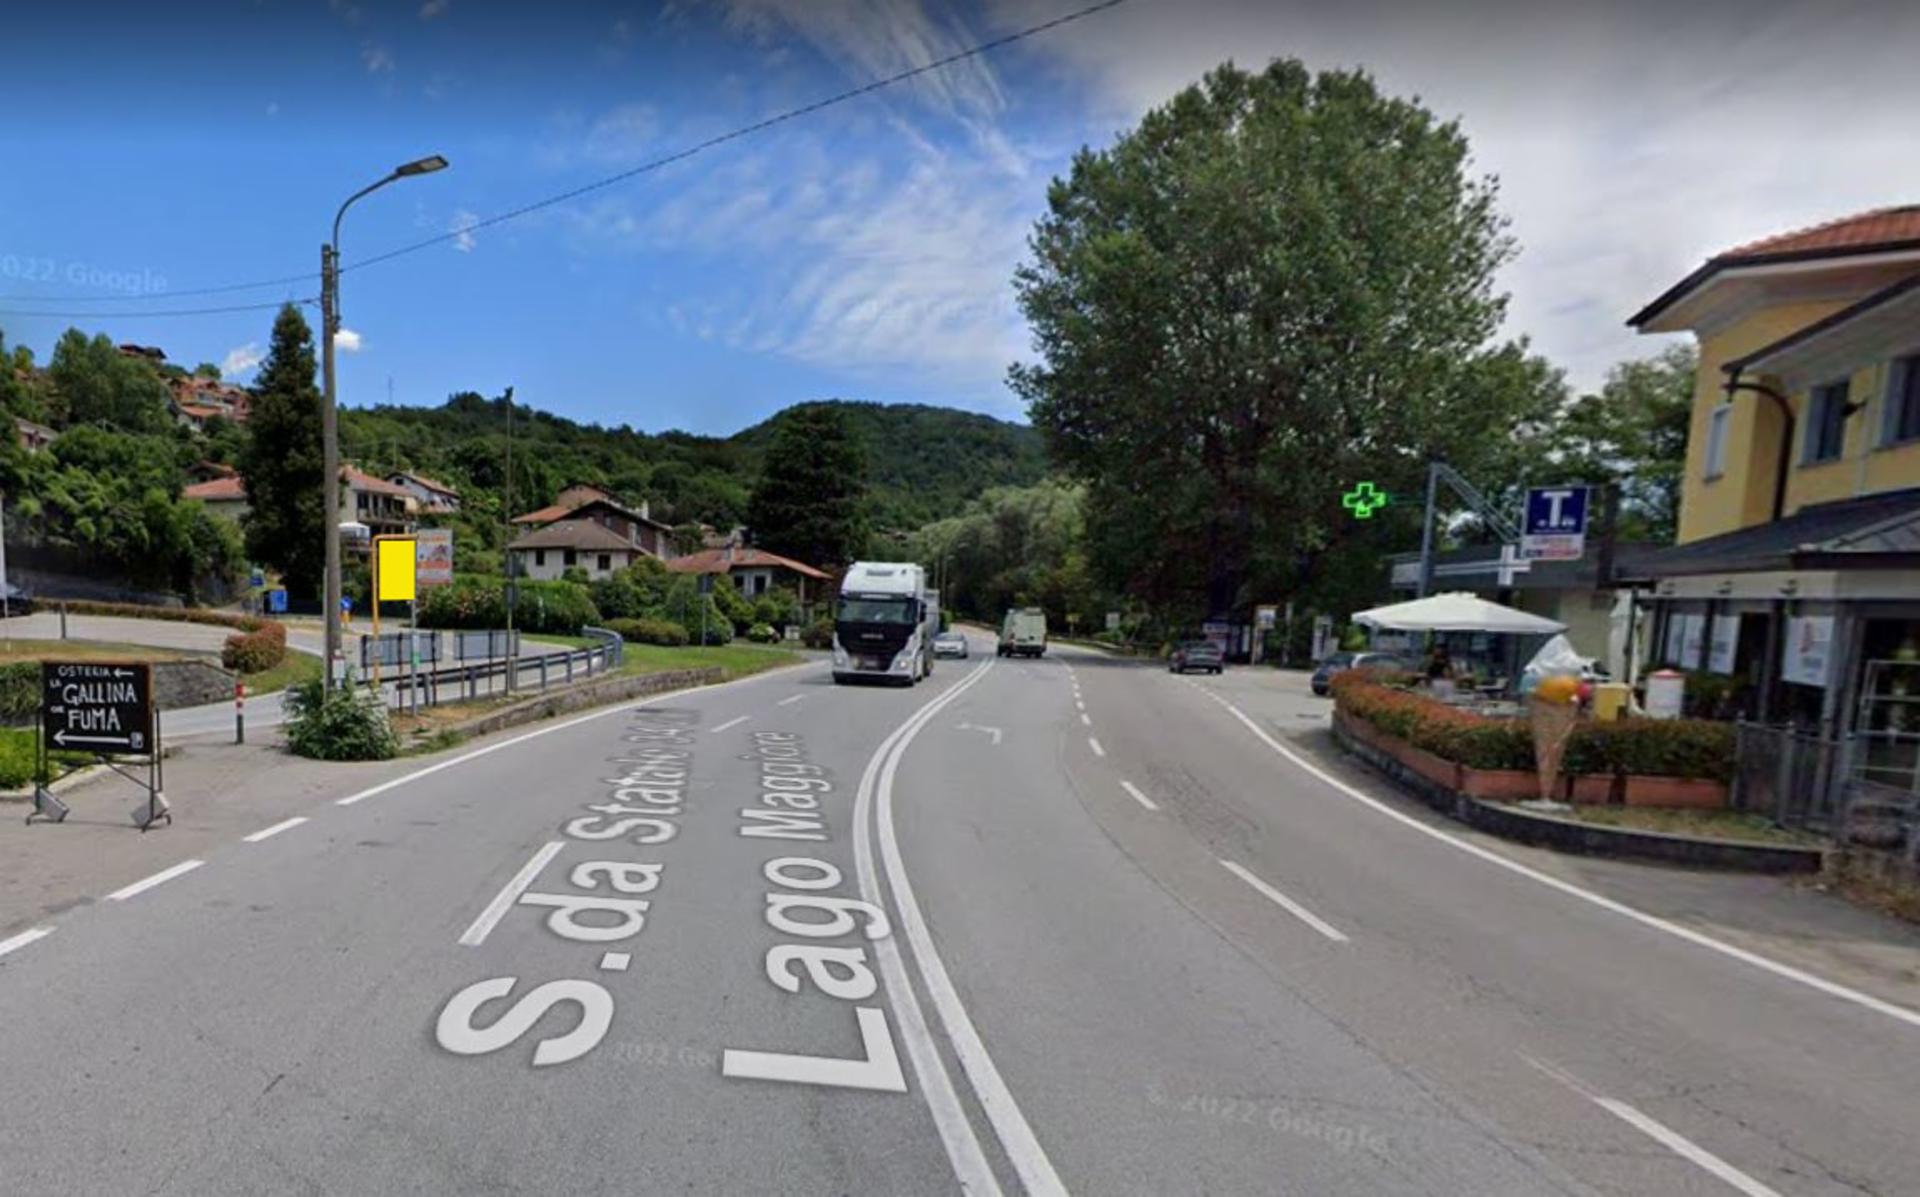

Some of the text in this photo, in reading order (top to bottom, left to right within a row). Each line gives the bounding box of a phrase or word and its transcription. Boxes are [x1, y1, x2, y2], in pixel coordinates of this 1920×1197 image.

[1541, 490, 1573, 528] T
[62, 682, 137, 706] GALLINA
[68, 707, 121, 731] FUMA
